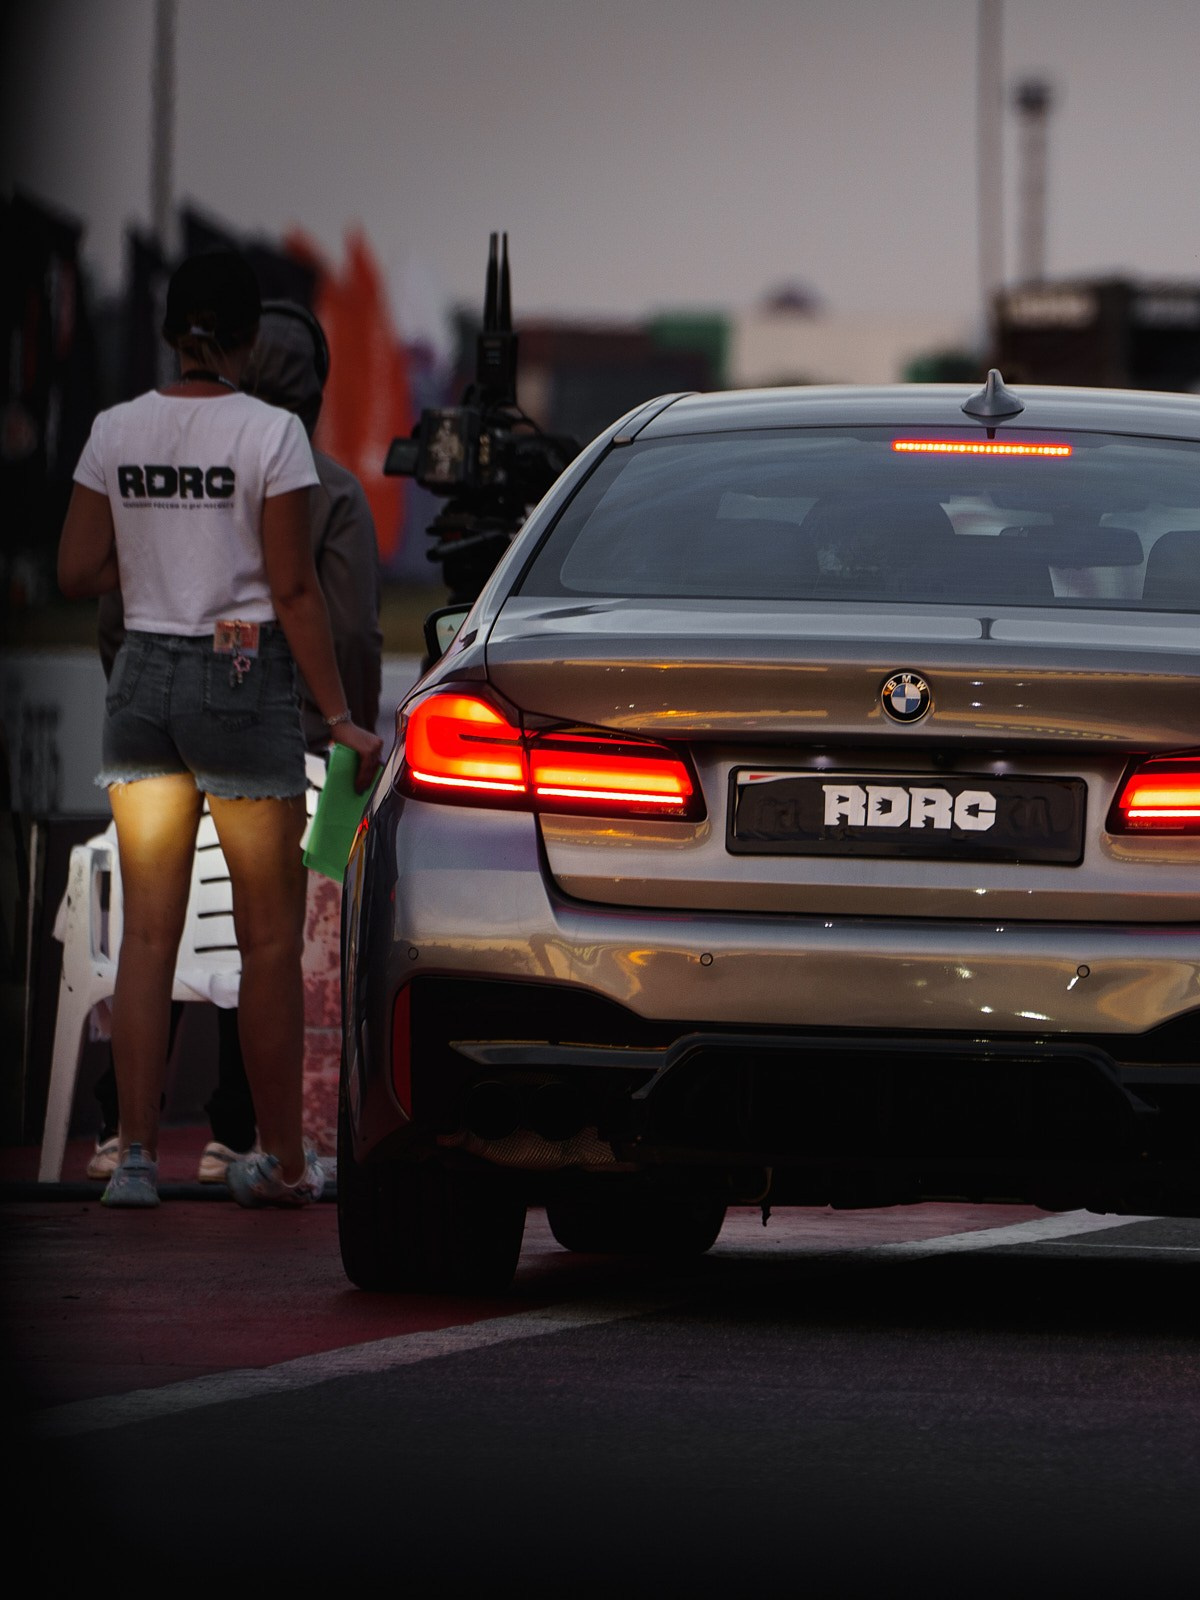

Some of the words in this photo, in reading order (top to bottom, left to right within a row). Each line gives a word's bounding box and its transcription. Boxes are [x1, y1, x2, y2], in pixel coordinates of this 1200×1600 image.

[117, 465, 236, 499] RDRC
[886, 674, 928, 692] BMW
[822, 785, 997, 831] RDRC
